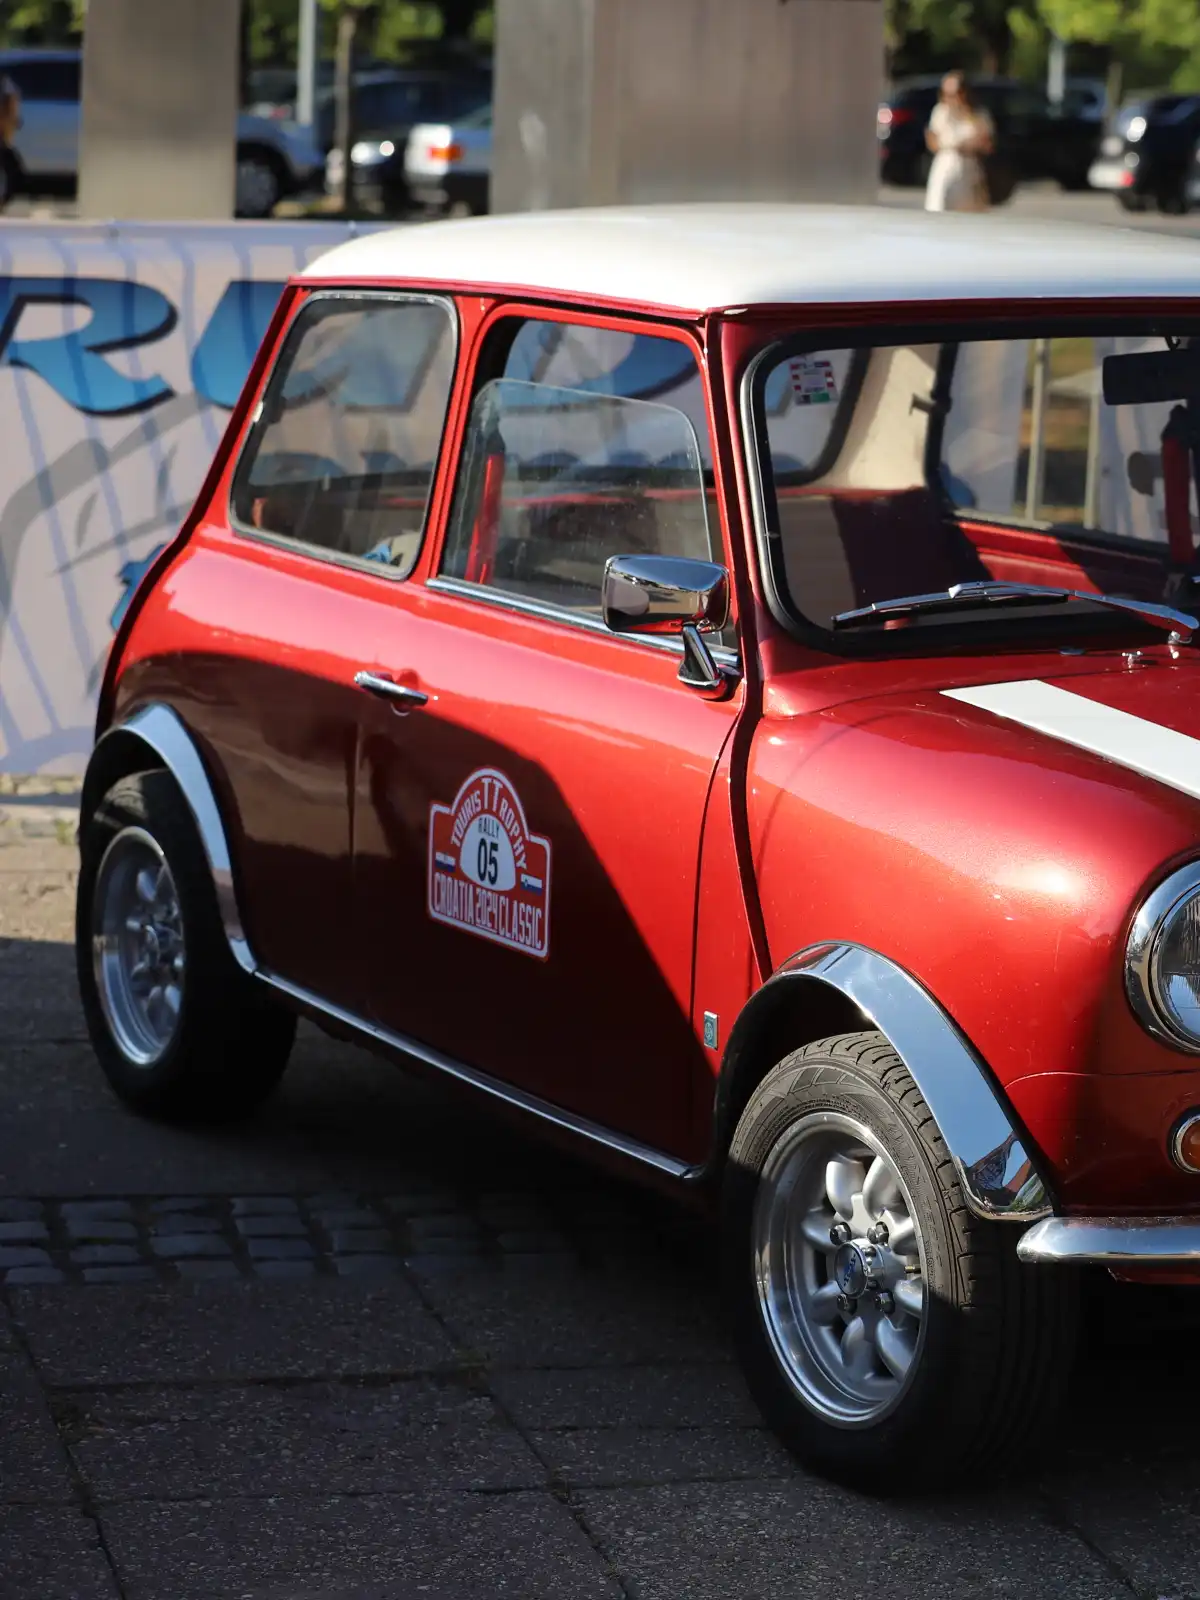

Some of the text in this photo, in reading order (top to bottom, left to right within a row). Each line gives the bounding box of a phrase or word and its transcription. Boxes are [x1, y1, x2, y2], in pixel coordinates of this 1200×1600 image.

[477, 816, 500, 840] RALLY
[476, 837, 499, 886] 05
[434, 871, 543, 950] CROATIA 2024 CLASSIC
